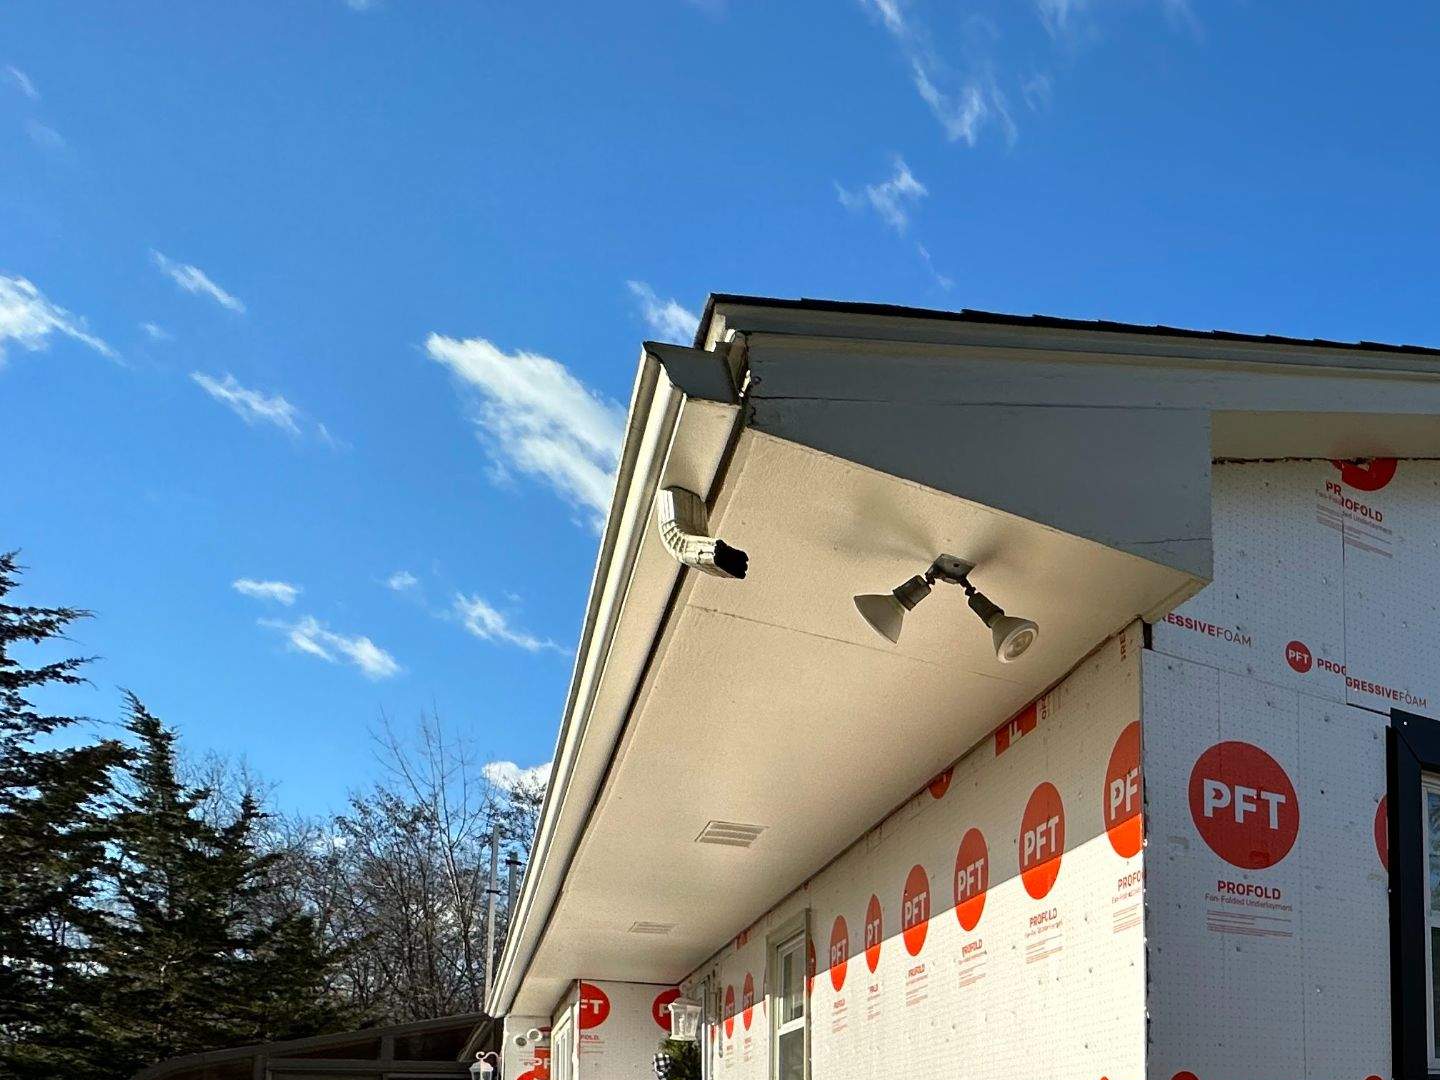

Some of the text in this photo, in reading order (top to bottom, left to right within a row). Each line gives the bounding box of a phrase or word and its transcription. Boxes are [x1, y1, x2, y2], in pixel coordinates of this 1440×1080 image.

[1288, 650, 1309, 664] PFT
[1346, 676, 1427, 708] GRESSIVEFOAM
[1203, 779, 1286, 830] PFT
[1024, 816, 1059, 867] PFT
[958, 858, 984, 901] PFT
[1217, 880, 1281, 900] PROFOLD
[904, 892, 927, 929] PFT
[831, 939, 847, 967] PFT
